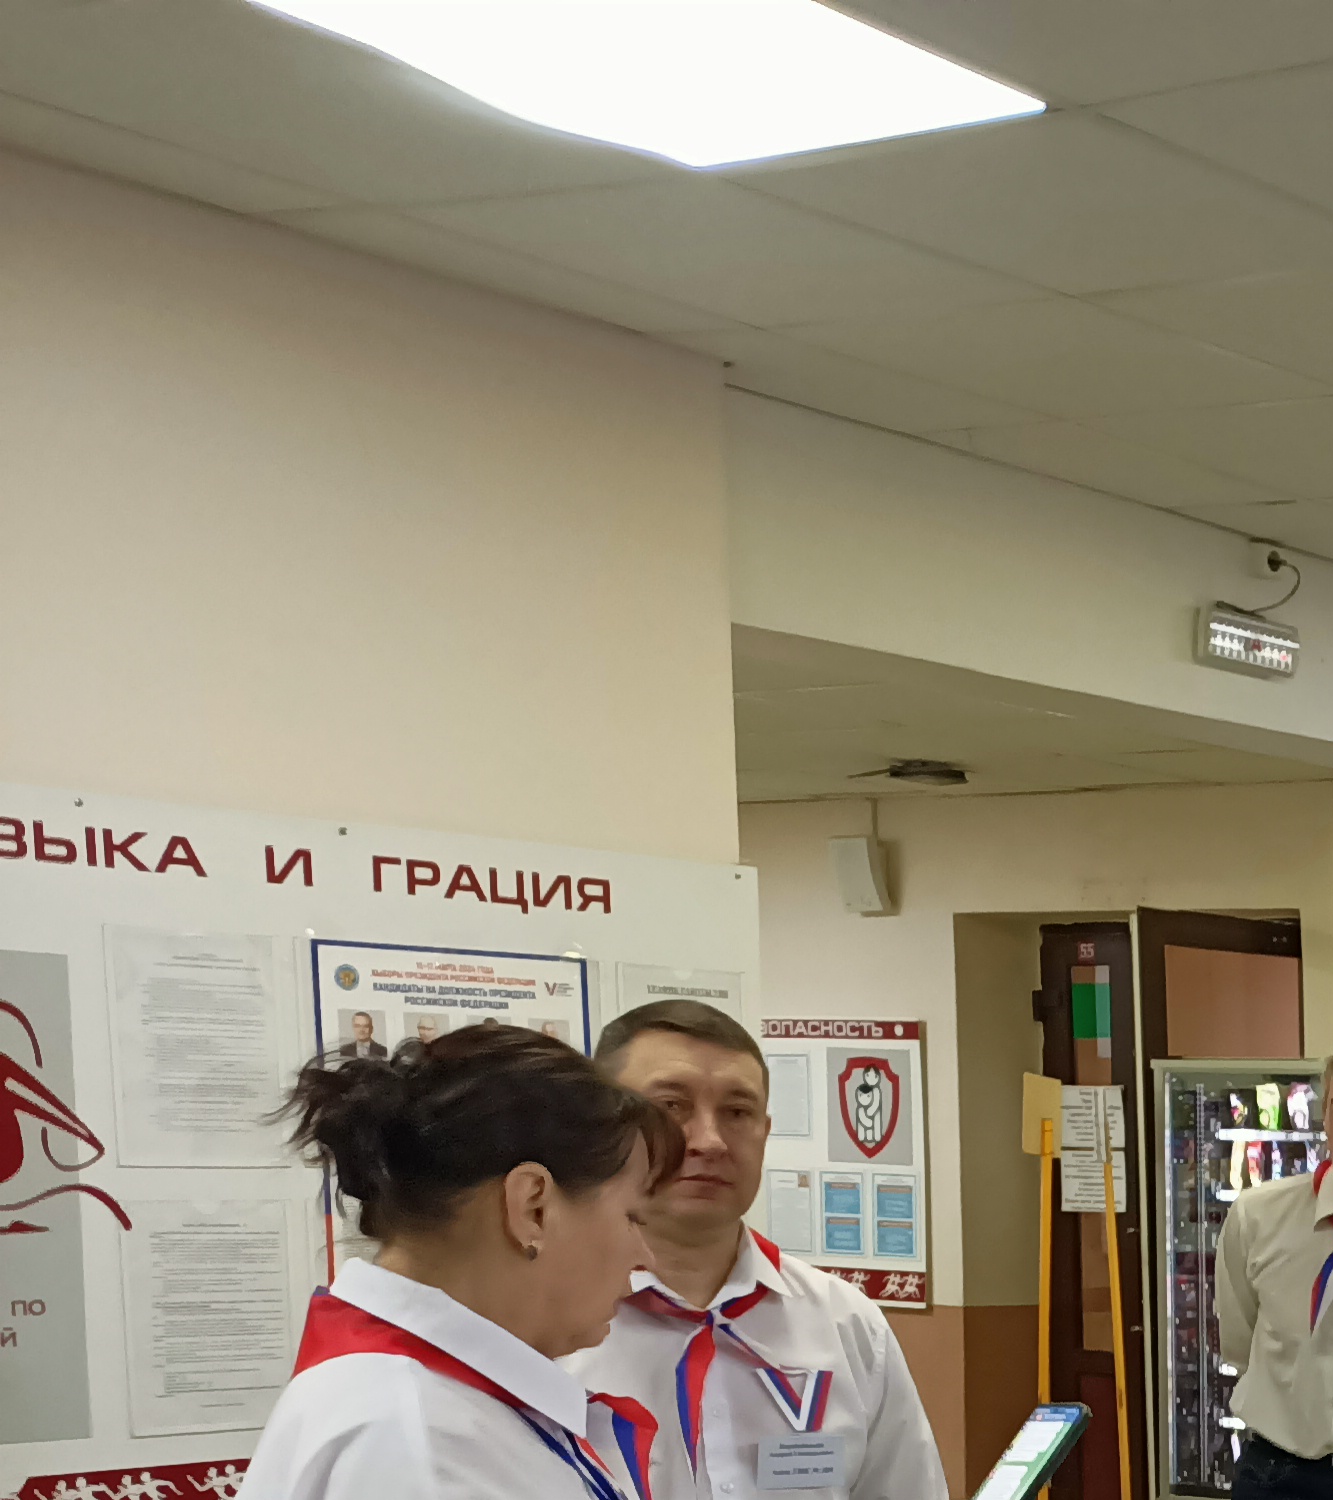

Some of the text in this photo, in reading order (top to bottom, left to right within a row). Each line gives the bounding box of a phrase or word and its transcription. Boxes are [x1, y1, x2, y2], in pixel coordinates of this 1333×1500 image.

[264, 845, 314, 887] И
[372, 855, 612, 914] ГРАЦИЯ
[11, 1299, 46, 1316] по
